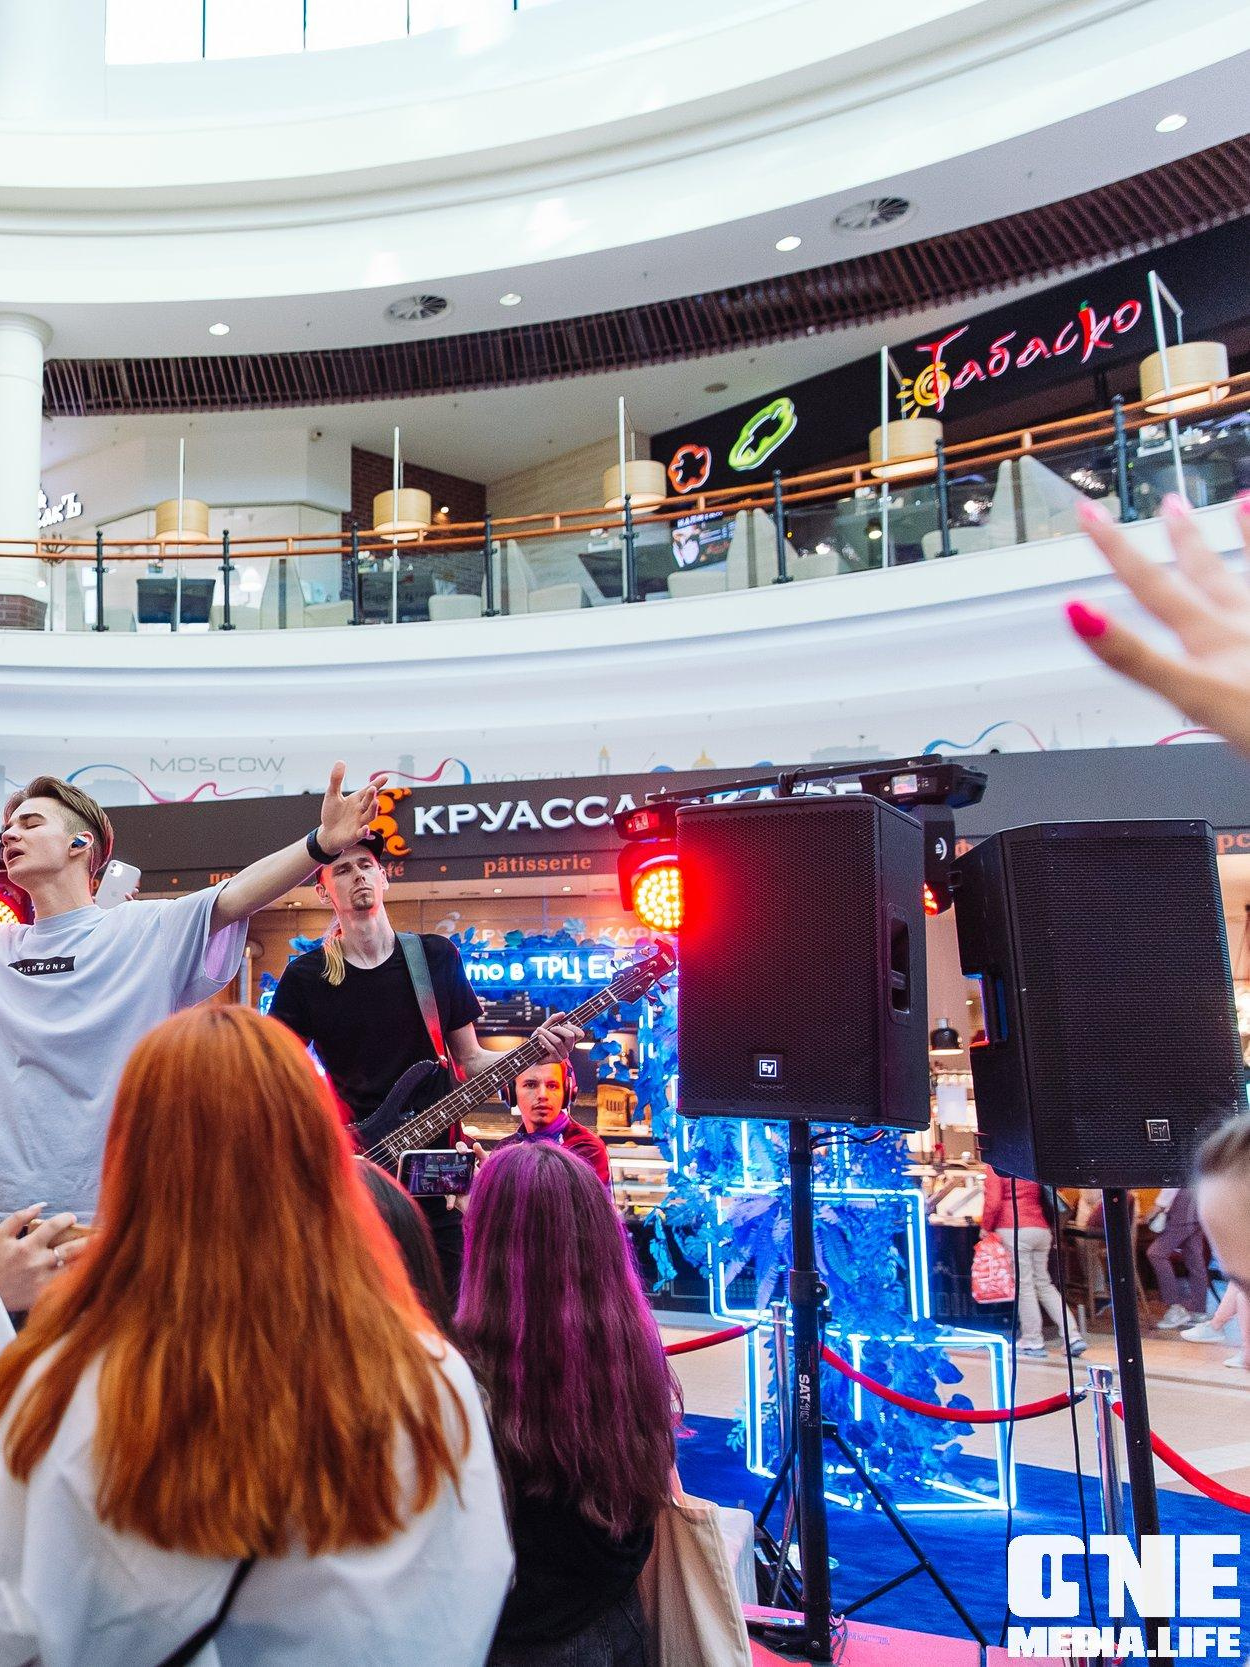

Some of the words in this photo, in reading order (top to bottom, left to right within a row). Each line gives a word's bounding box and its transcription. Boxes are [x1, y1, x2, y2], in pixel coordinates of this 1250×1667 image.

[915, 299, 1142, 414] Табаско
[149, 757, 285, 772] MOSCOW
[414, 793, 640, 835] КРУАССА
[483, 854, 592, 878] pâtisserie
[529, 957, 582, 983] ТРЦ
